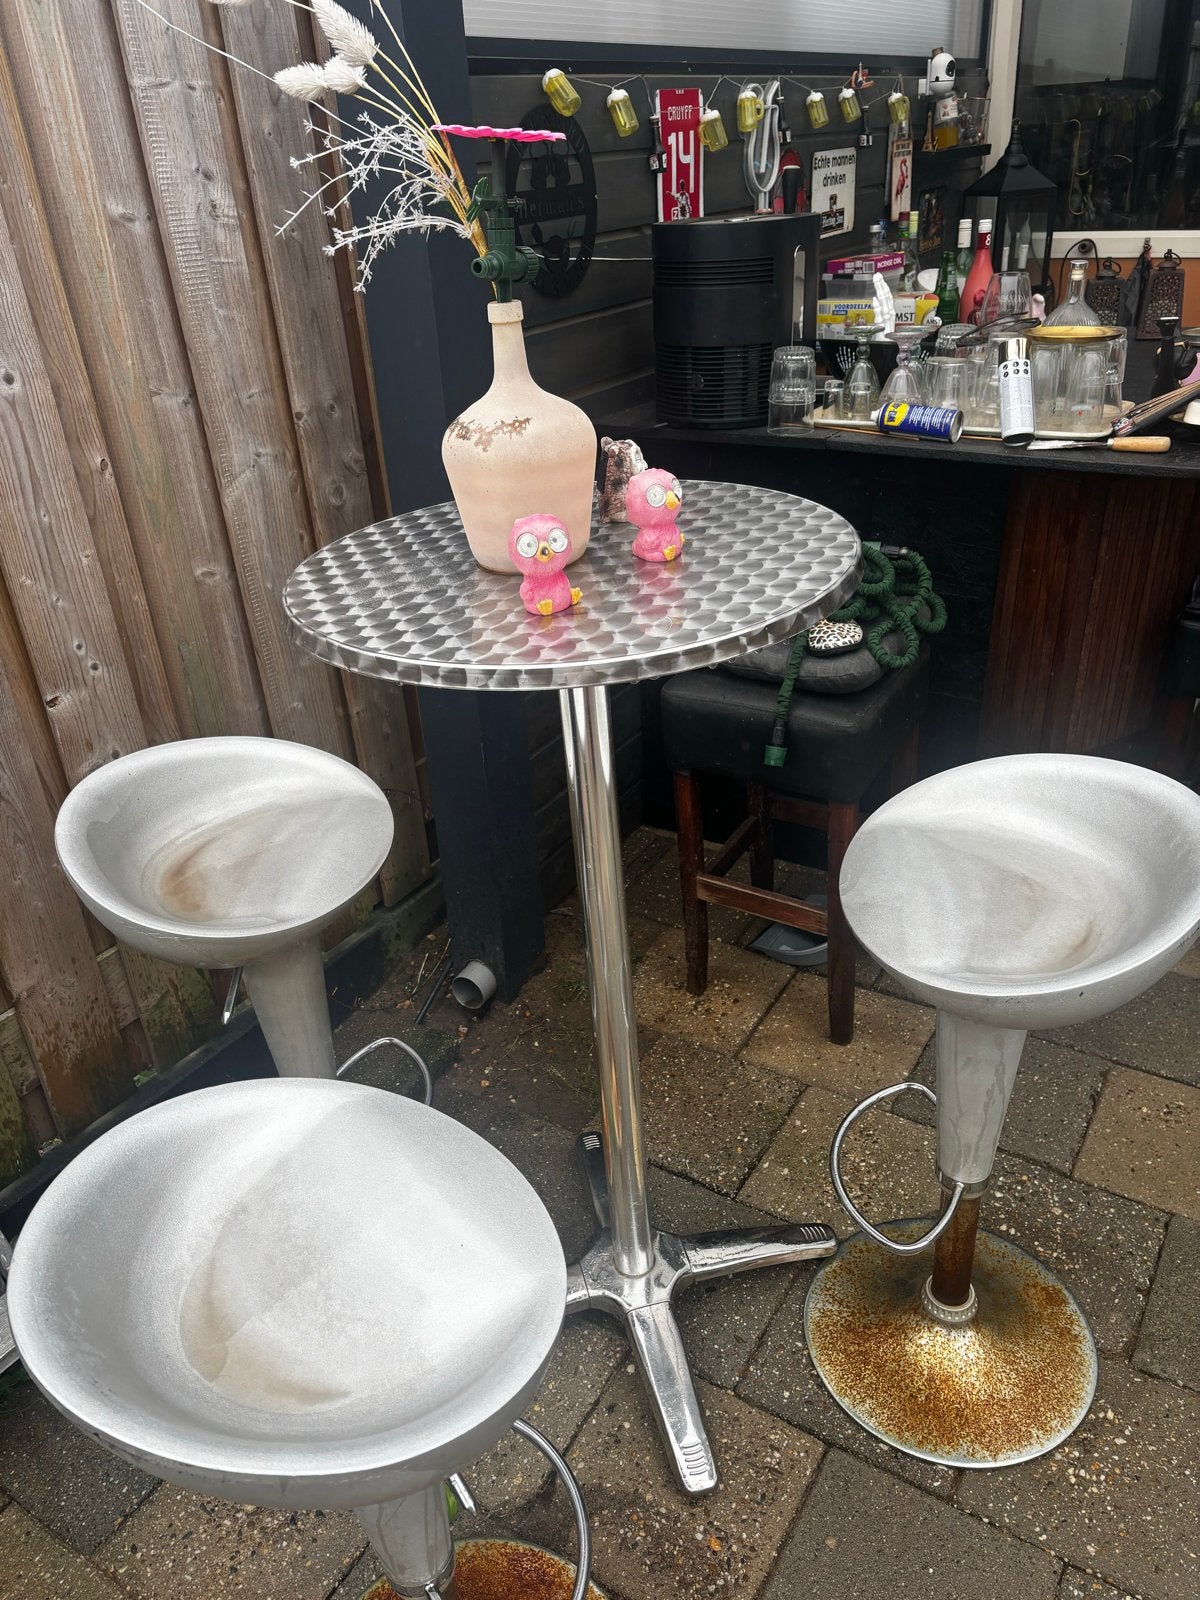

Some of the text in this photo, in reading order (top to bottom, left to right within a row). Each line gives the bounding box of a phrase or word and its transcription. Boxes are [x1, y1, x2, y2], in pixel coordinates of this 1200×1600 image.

[667, 105, 693, 121] CRUYFF
[667, 130, 695, 196] 14
[813, 153, 856, 171] Echte mannen
[822, 172, 846, 187] drinken
[985, 234, 991, 246] 8
[877, 257, 903, 268] INCENSE COIL
[895, 312, 916, 322] MST
[886, 402, 903, 422] WD-4
